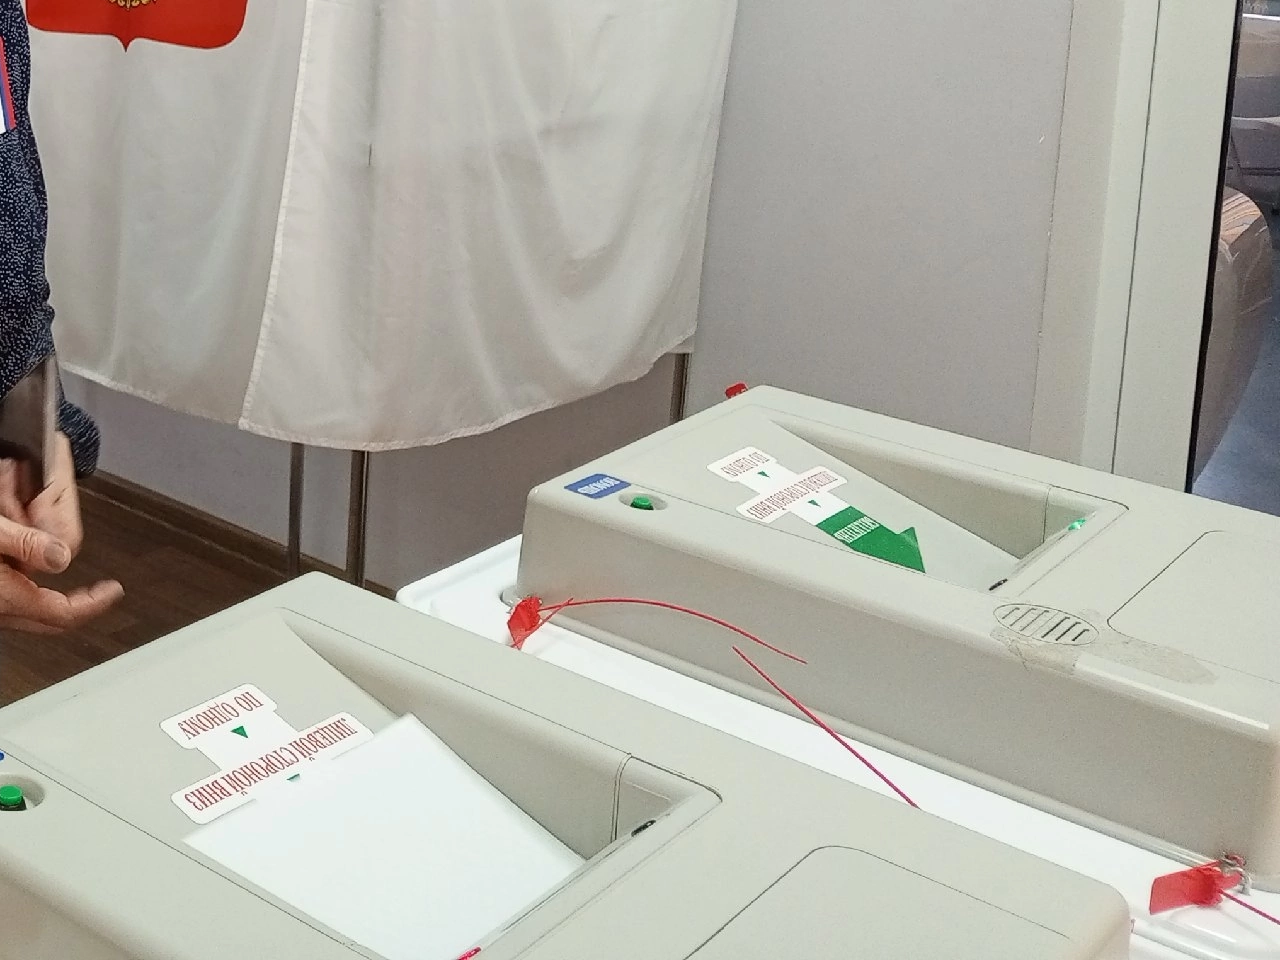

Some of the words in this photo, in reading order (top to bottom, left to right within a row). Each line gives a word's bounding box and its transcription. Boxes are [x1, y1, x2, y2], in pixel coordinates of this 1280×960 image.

[234, 691, 264, 712] ПО
[178, 702, 240, 740] ОДНОМУ
[289, 717, 358, 761] ЛИЦЕВОЙ
[220, 747, 300, 796] СТОРОНОЙ
[184, 779, 232, 811] ВНИЗ
